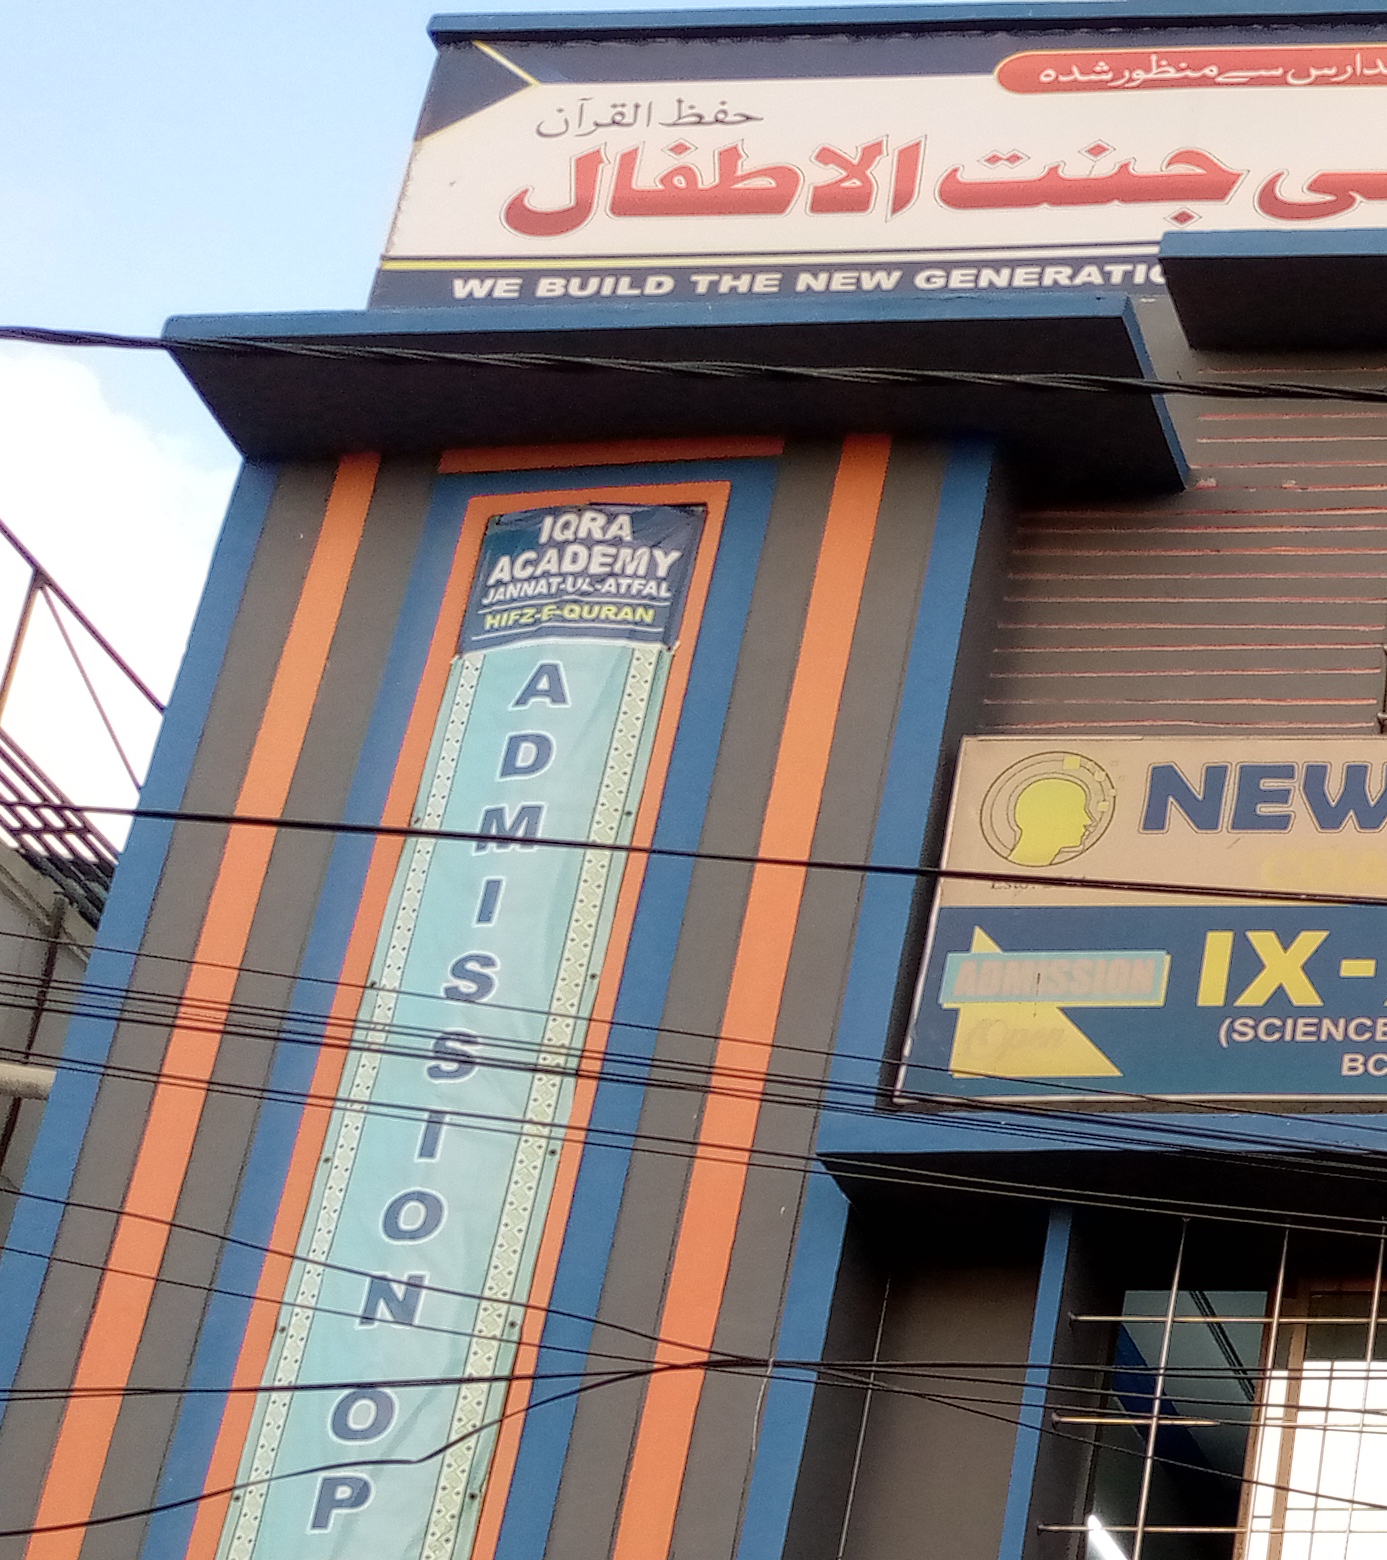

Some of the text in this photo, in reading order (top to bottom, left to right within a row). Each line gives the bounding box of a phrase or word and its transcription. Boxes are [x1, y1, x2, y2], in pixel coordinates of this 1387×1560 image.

[452, 277, 527, 299] WE
[536, 273, 680, 297] BUILD
[690, 272, 786, 295] THE
[795, 269, 903, 293] NEW
[537, 509, 634, 545] IQRA
[486, 543, 683, 587] ACADEMY
[481, 574, 673, 605] JANNAT-UL-ATFAL
[356, 660, 572, 1329] ADMISSION
